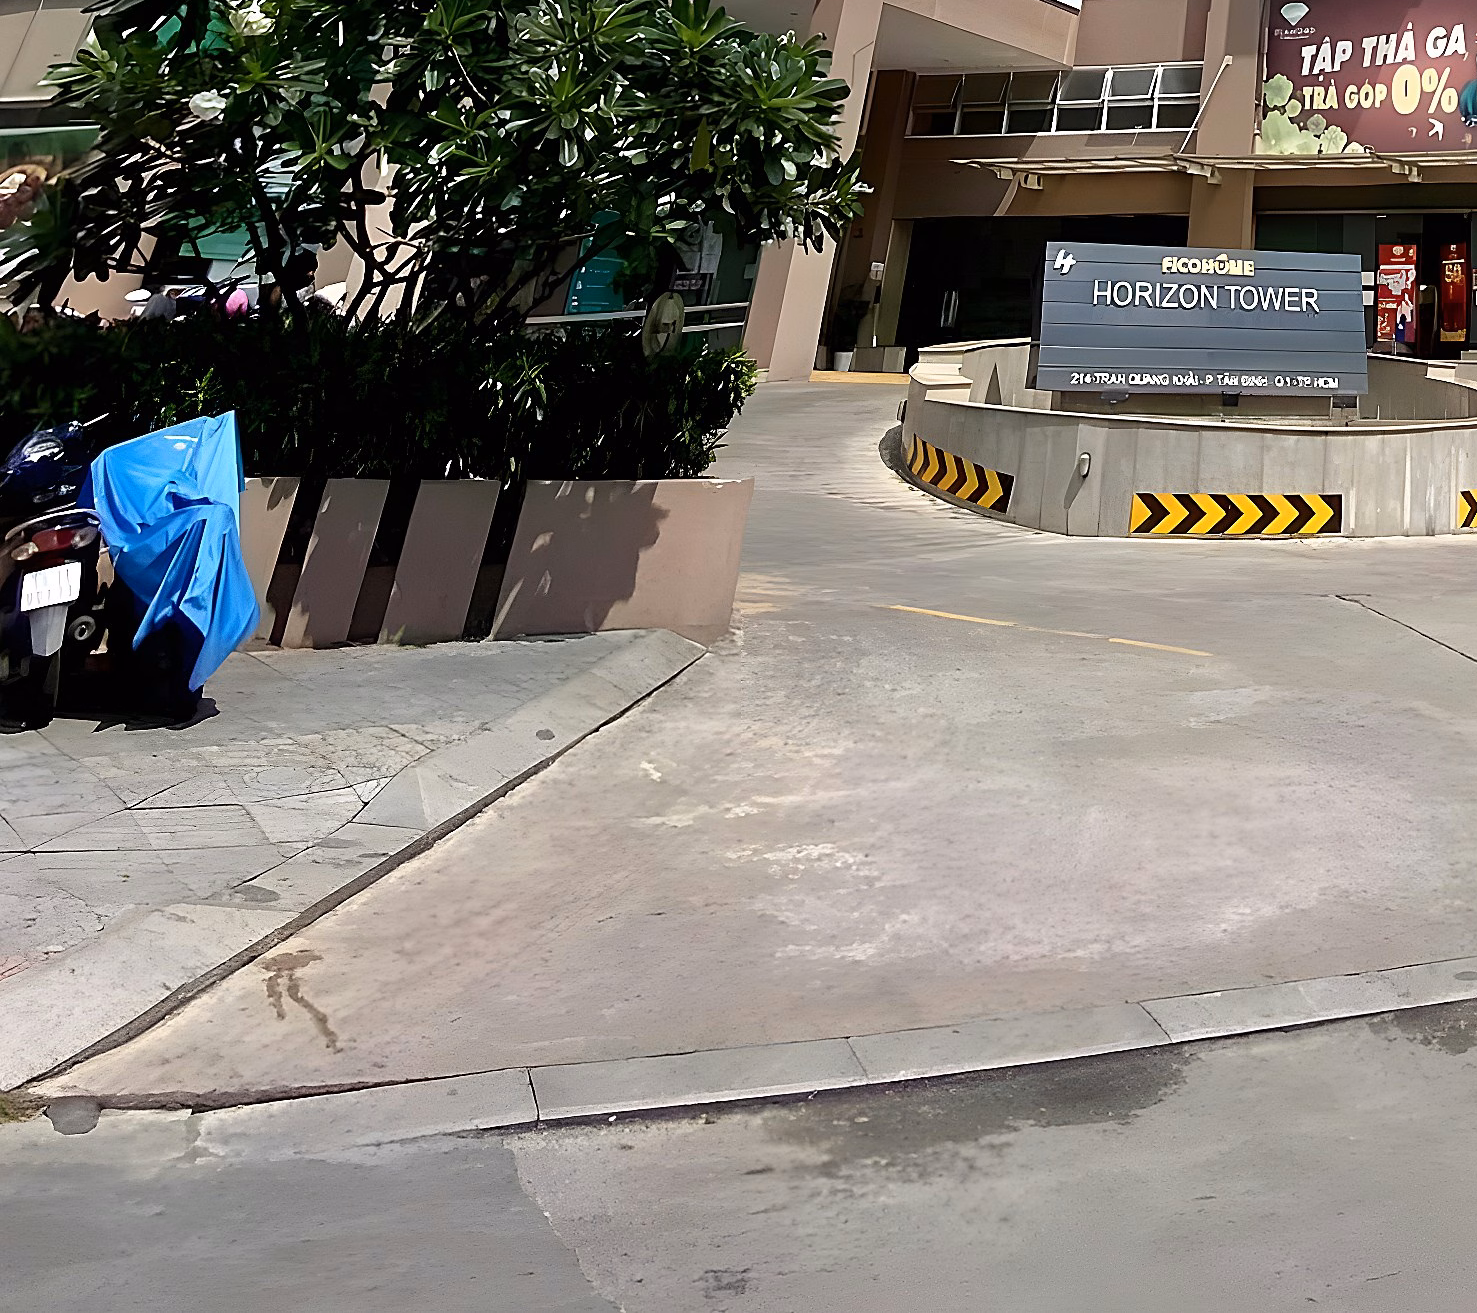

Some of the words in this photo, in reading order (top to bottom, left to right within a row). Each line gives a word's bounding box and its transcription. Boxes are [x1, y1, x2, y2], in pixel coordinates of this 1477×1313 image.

[1391, 64, 1459, 115] 0%
[1092, 279, 1218, 310] HORIZON
[1224, 284, 1320, 313] TOWER
